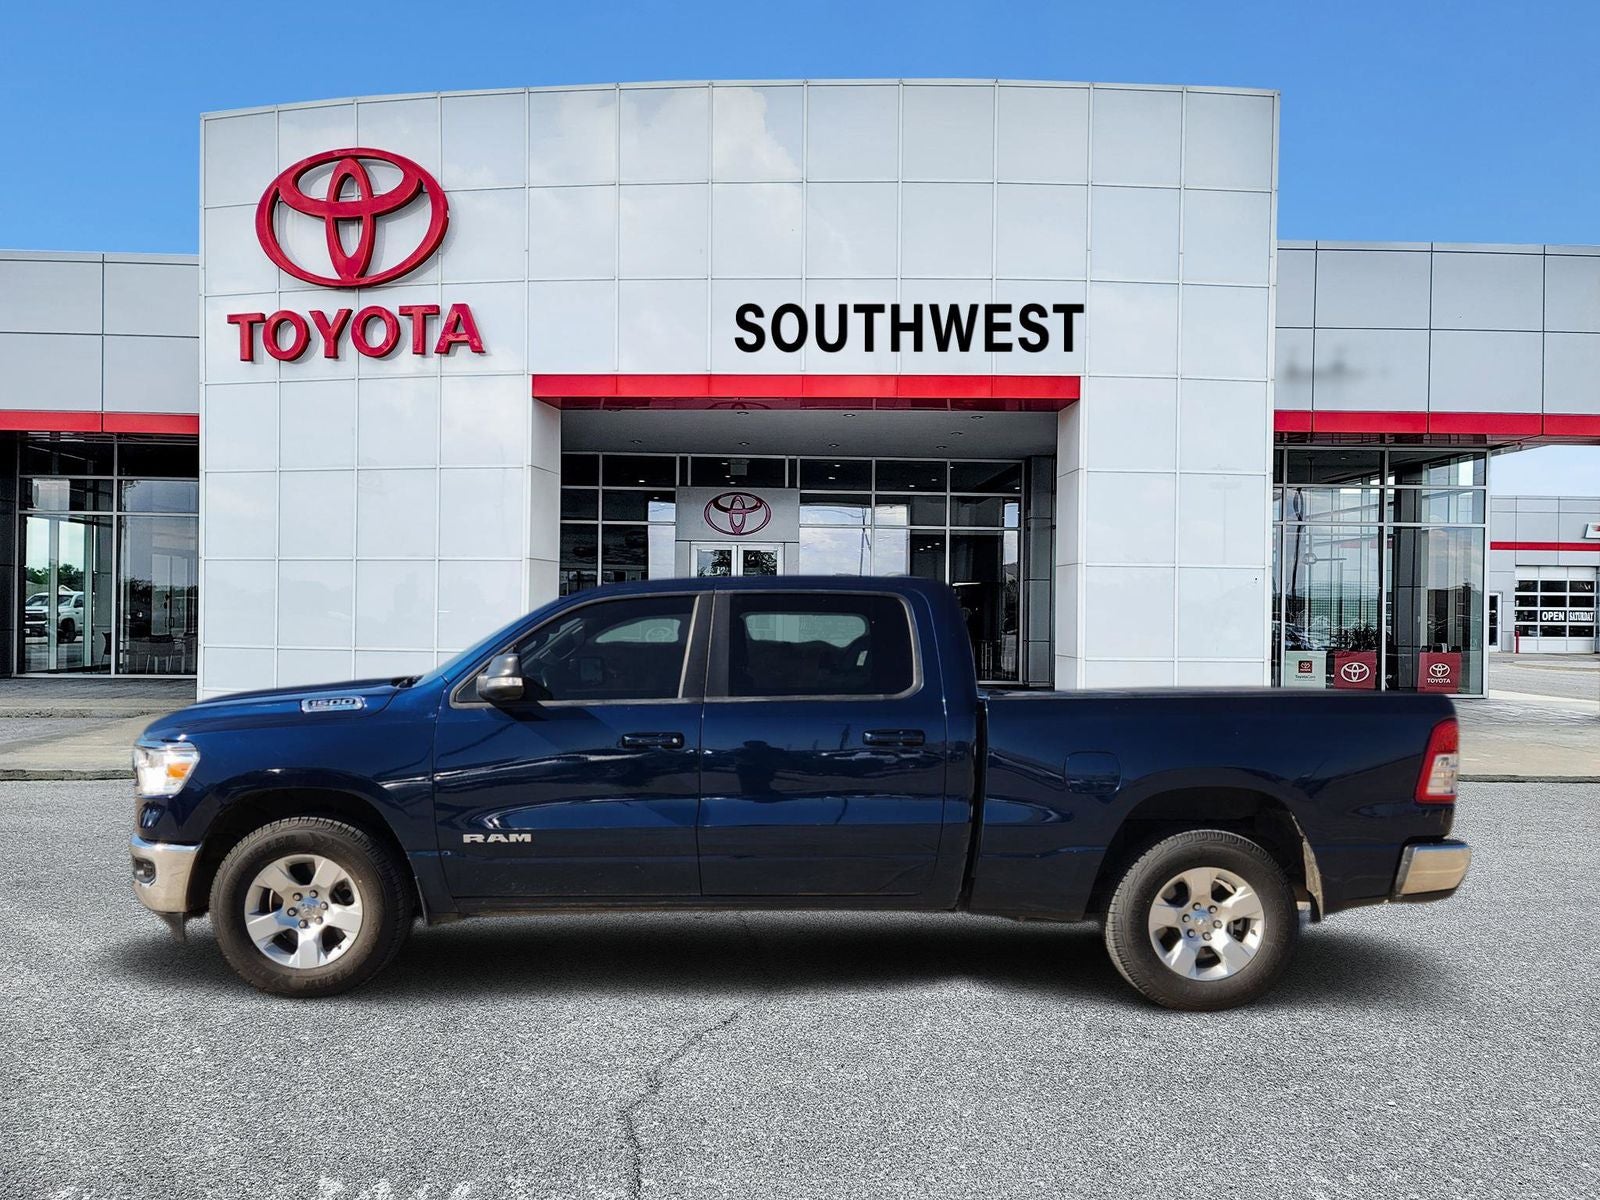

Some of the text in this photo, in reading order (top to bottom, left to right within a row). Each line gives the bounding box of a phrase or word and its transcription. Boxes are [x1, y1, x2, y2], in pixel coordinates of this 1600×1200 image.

[227, 303, 486, 362] TOYOTA
[734, 303, 1085, 353] SOUTHWEST
[1542, 611, 1594, 621] OPEN SATURDAY
[307, 698, 356, 707] 1500
[463, 833, 533, 843] RAM
